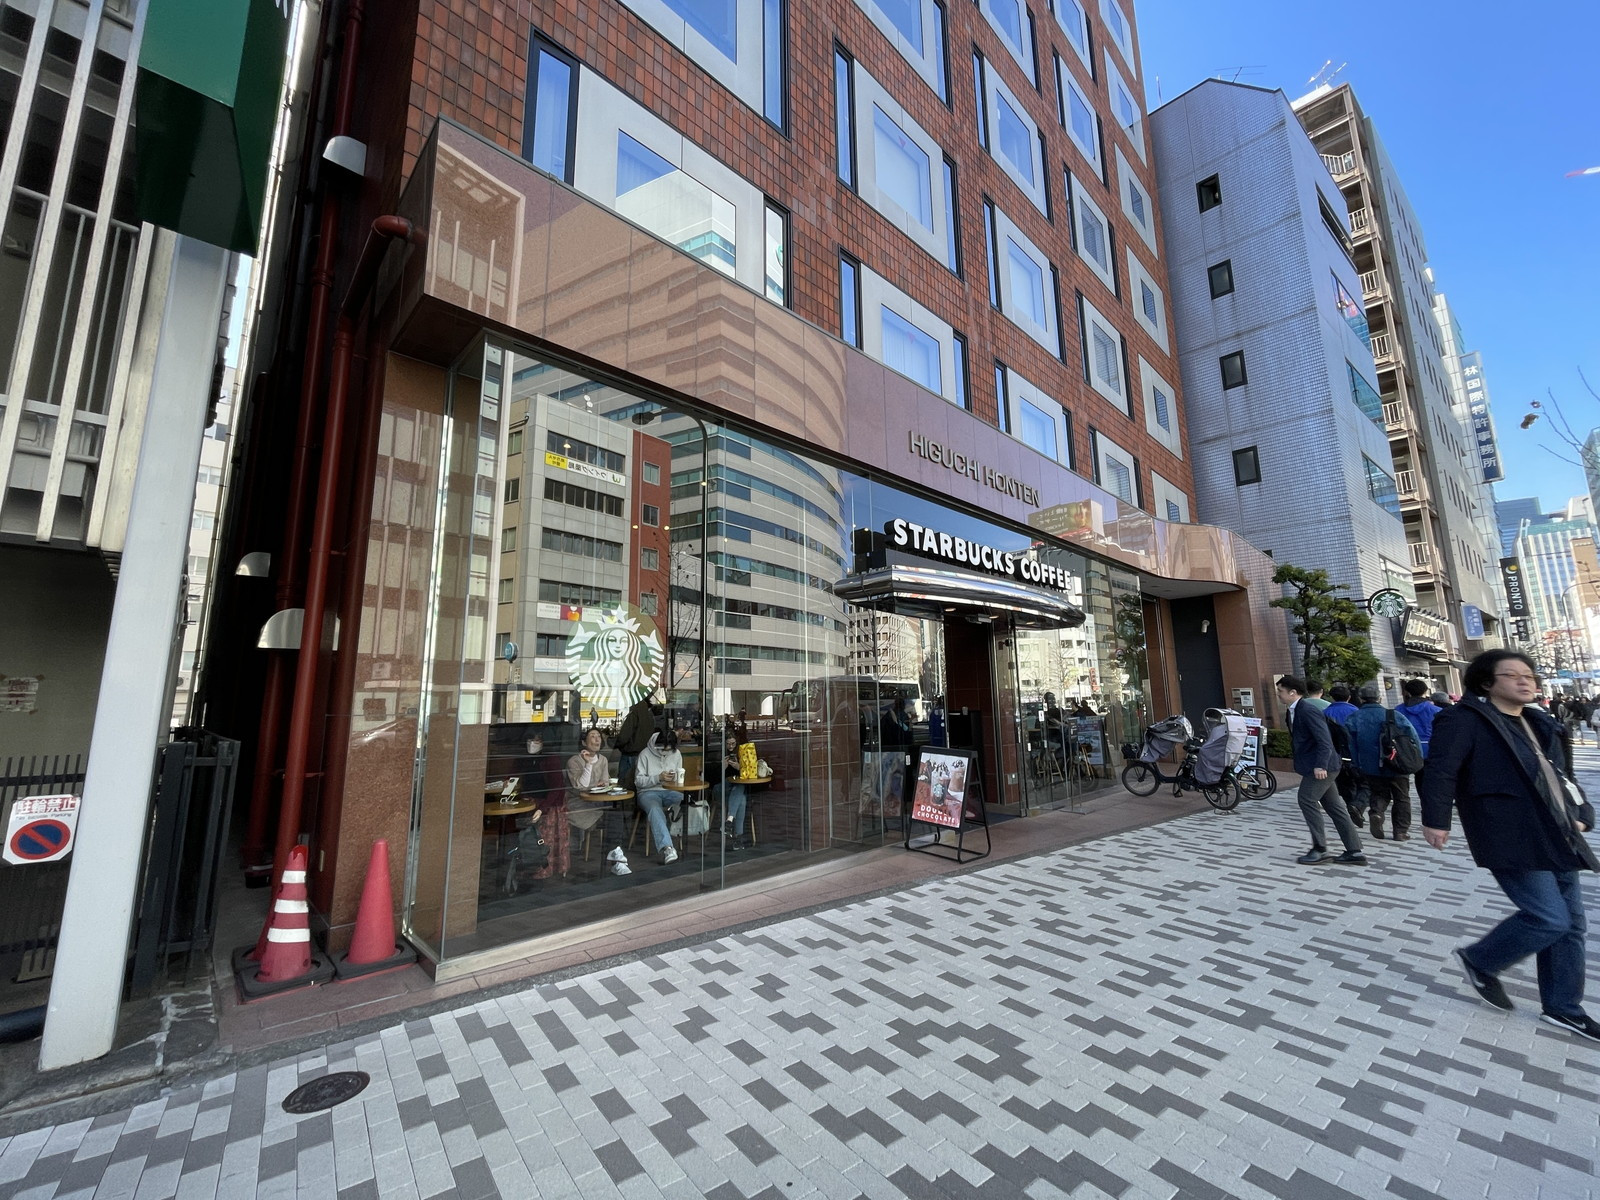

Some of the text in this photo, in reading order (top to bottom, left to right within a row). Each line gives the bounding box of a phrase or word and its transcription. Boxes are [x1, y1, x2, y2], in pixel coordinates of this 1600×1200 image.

[1463, 365, 1496, 468] 林国際特許事務所
[908, 430, 1039, 507] HIGUCHI HONTEN
[893, 518, 1015, 574] STARBUCKS
[1020, 558, 1072, 589] COFFEE
[1511, 576, 1523, 610] PRONTO
[15, 797, 77, 814] 駐輪禁止
[917, 811, 955, 823] CHOCOLATE
